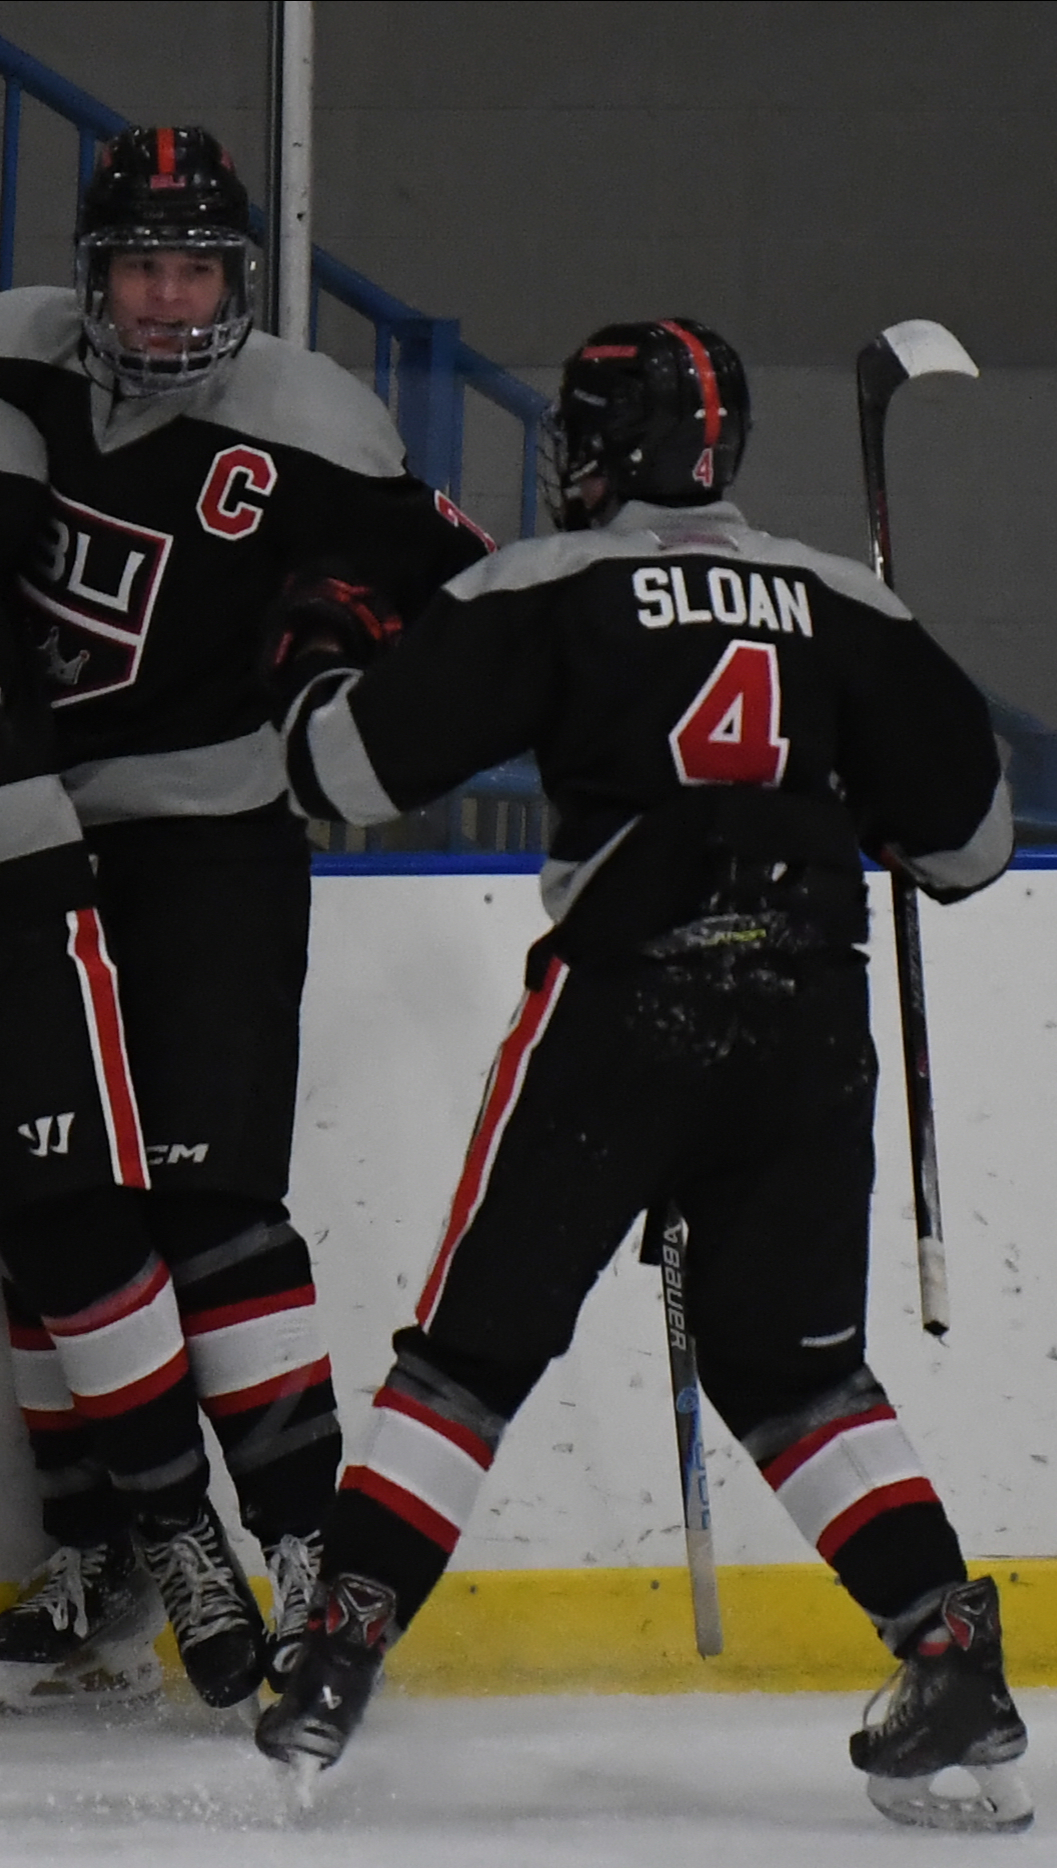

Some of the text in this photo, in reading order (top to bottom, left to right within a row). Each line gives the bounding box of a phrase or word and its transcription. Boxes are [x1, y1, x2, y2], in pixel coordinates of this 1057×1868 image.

[195, 443, 279, 542] C
[692, 447, 715, 489] 4
[631, 565, 814, 638] SLOAN
[668, 638, 791, 788] 4
[662, 1244, 687, 1351] BAUER
